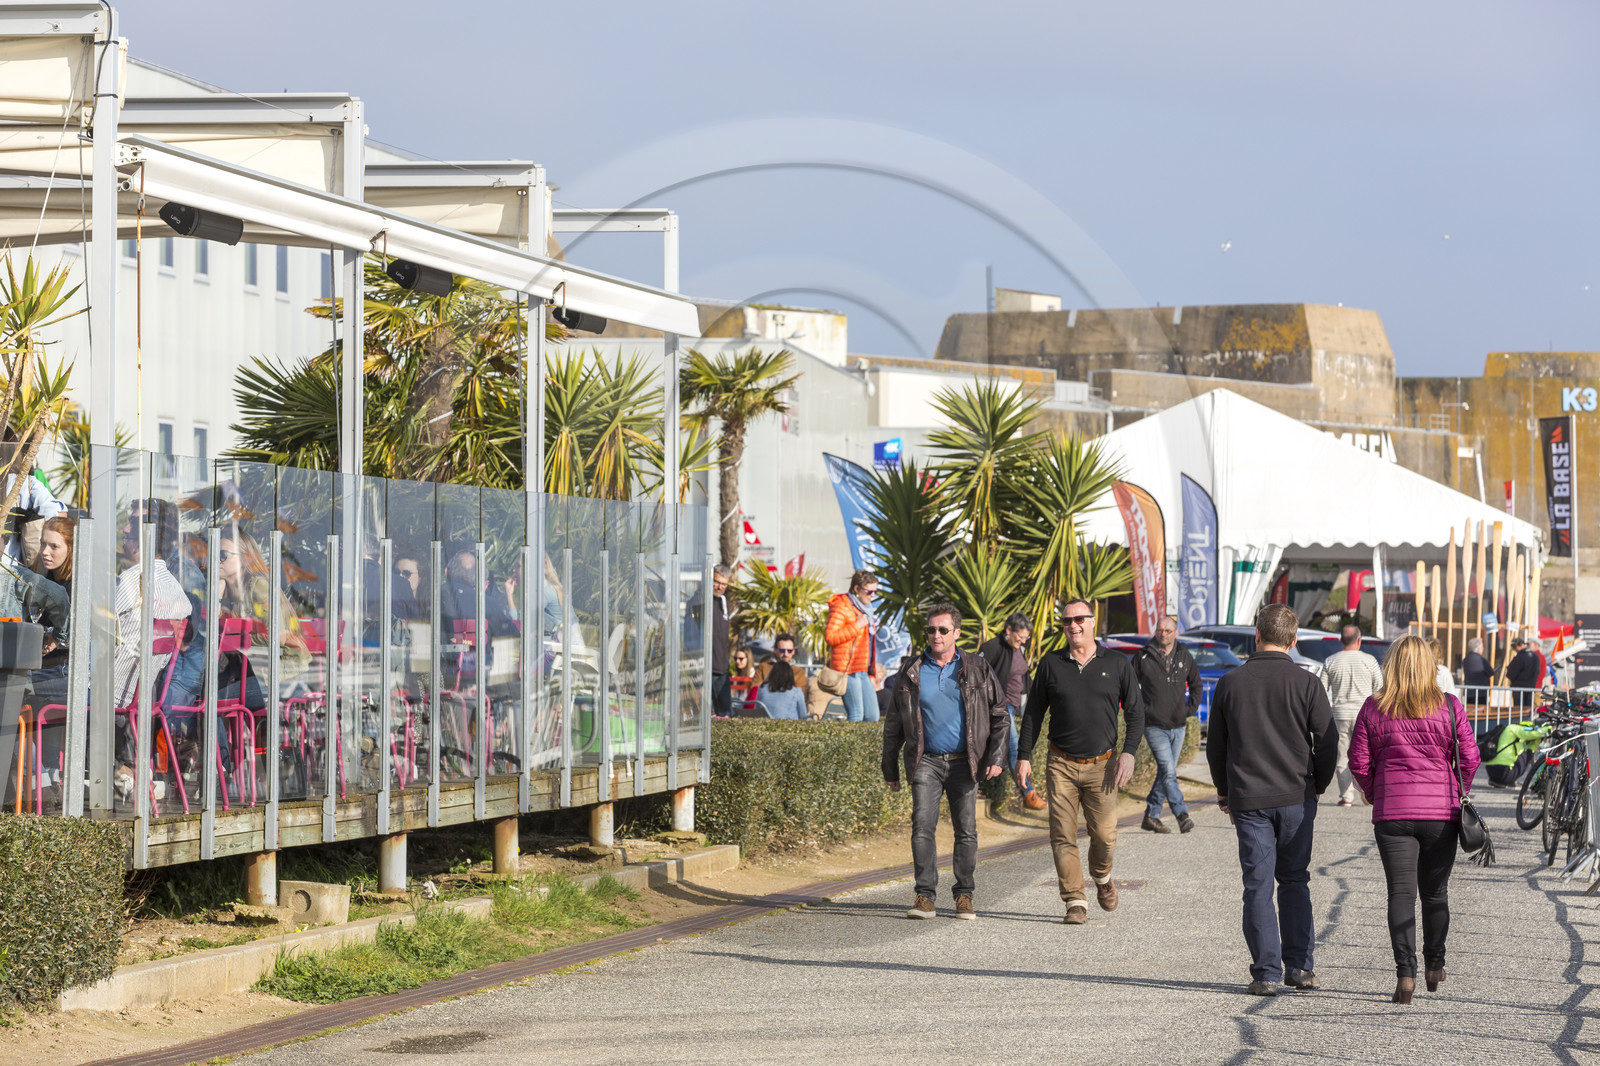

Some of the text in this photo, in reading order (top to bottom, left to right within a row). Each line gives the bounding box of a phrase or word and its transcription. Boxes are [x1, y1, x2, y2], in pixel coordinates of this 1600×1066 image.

[1562, 386, 1598, 412] K3
[1551, 442, 1571, 530] LA BASE
